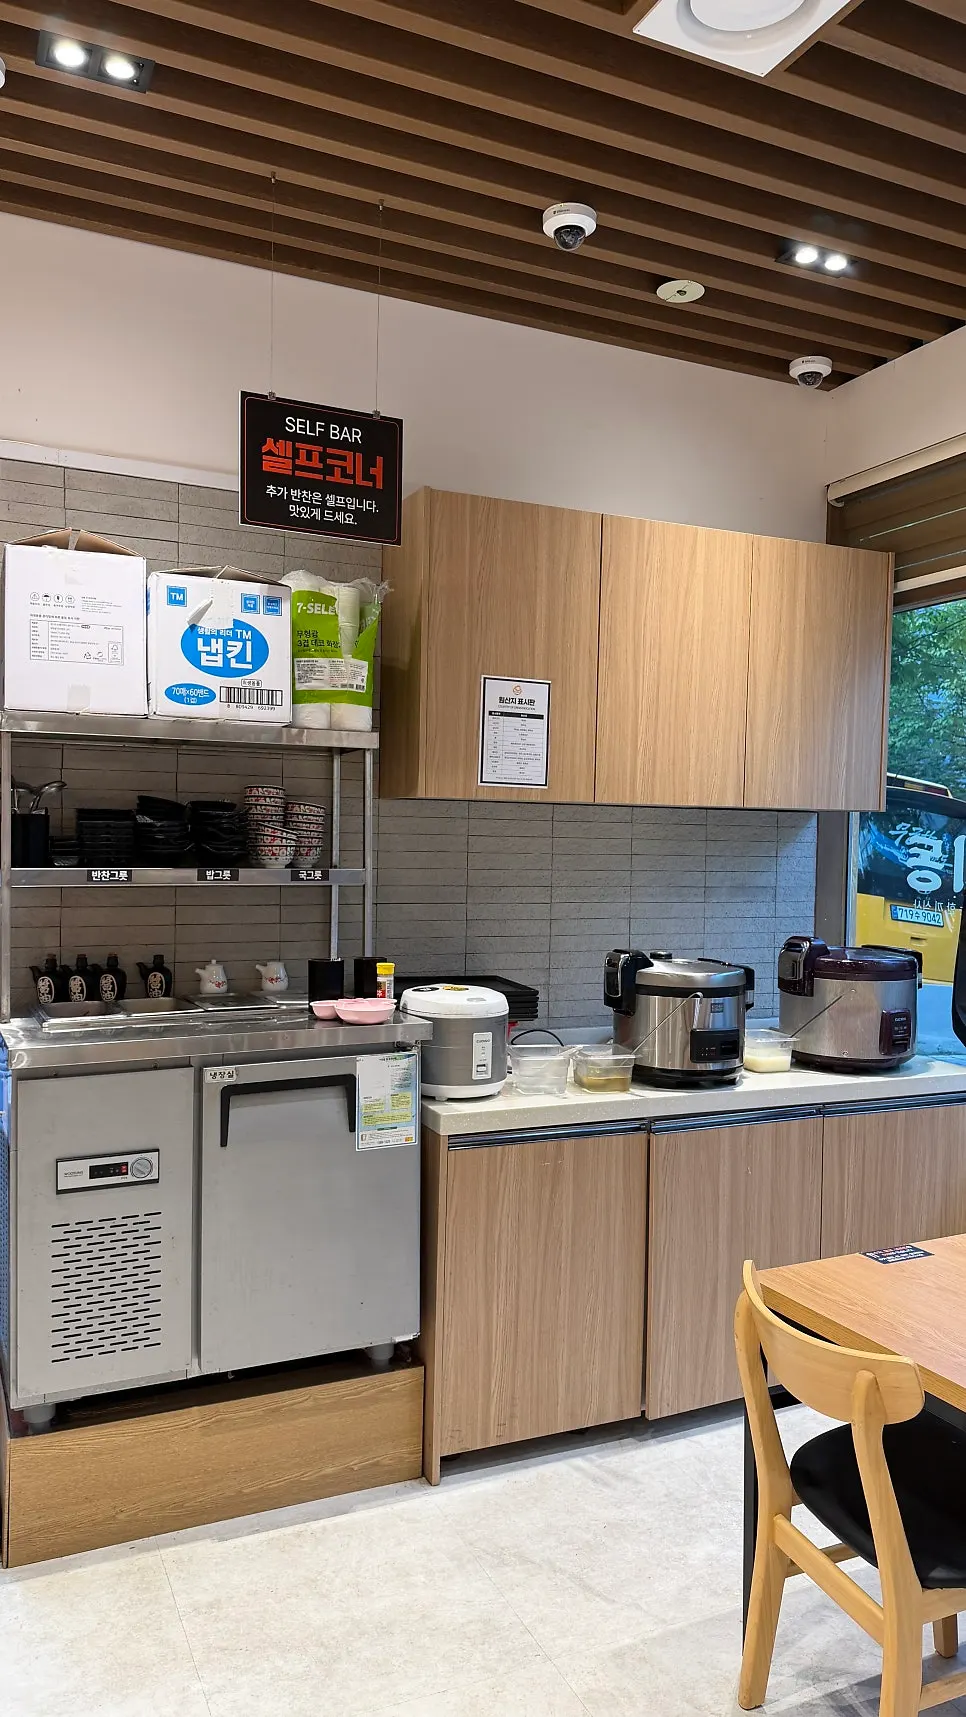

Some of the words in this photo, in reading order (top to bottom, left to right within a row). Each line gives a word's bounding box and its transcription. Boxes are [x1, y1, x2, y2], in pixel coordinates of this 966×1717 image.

[285, 416, 325, 436] SELF
[329, 424, 362, 444] BAR
[261, 437, 384, 490] 셀프코너
[265, 484, 288, 500] 추가
[290, 488, 322, 505] 반찬은
[325, 493, 379, 513] 셀프입니다.
[289, 504, 321, 521] 맛있게
[323, 509, 358, 525] 드세요.
[170, 592, 184, 601] TM
[235, 629, 252, 640] TM
[296, 629, 319, 639] 무형광
[197, 637, 253, 670] 냅킨
[498, 696, 517, 705] 원산지
[517, 697, 536, 707] 표시판
[91, 870, 129, 881] 반찬그릇
[205, 869, 232, 880] 밥그릇
[298, 870, 322, 880] 국그릇
[209, 1070, 235, 1080] 냉장실
